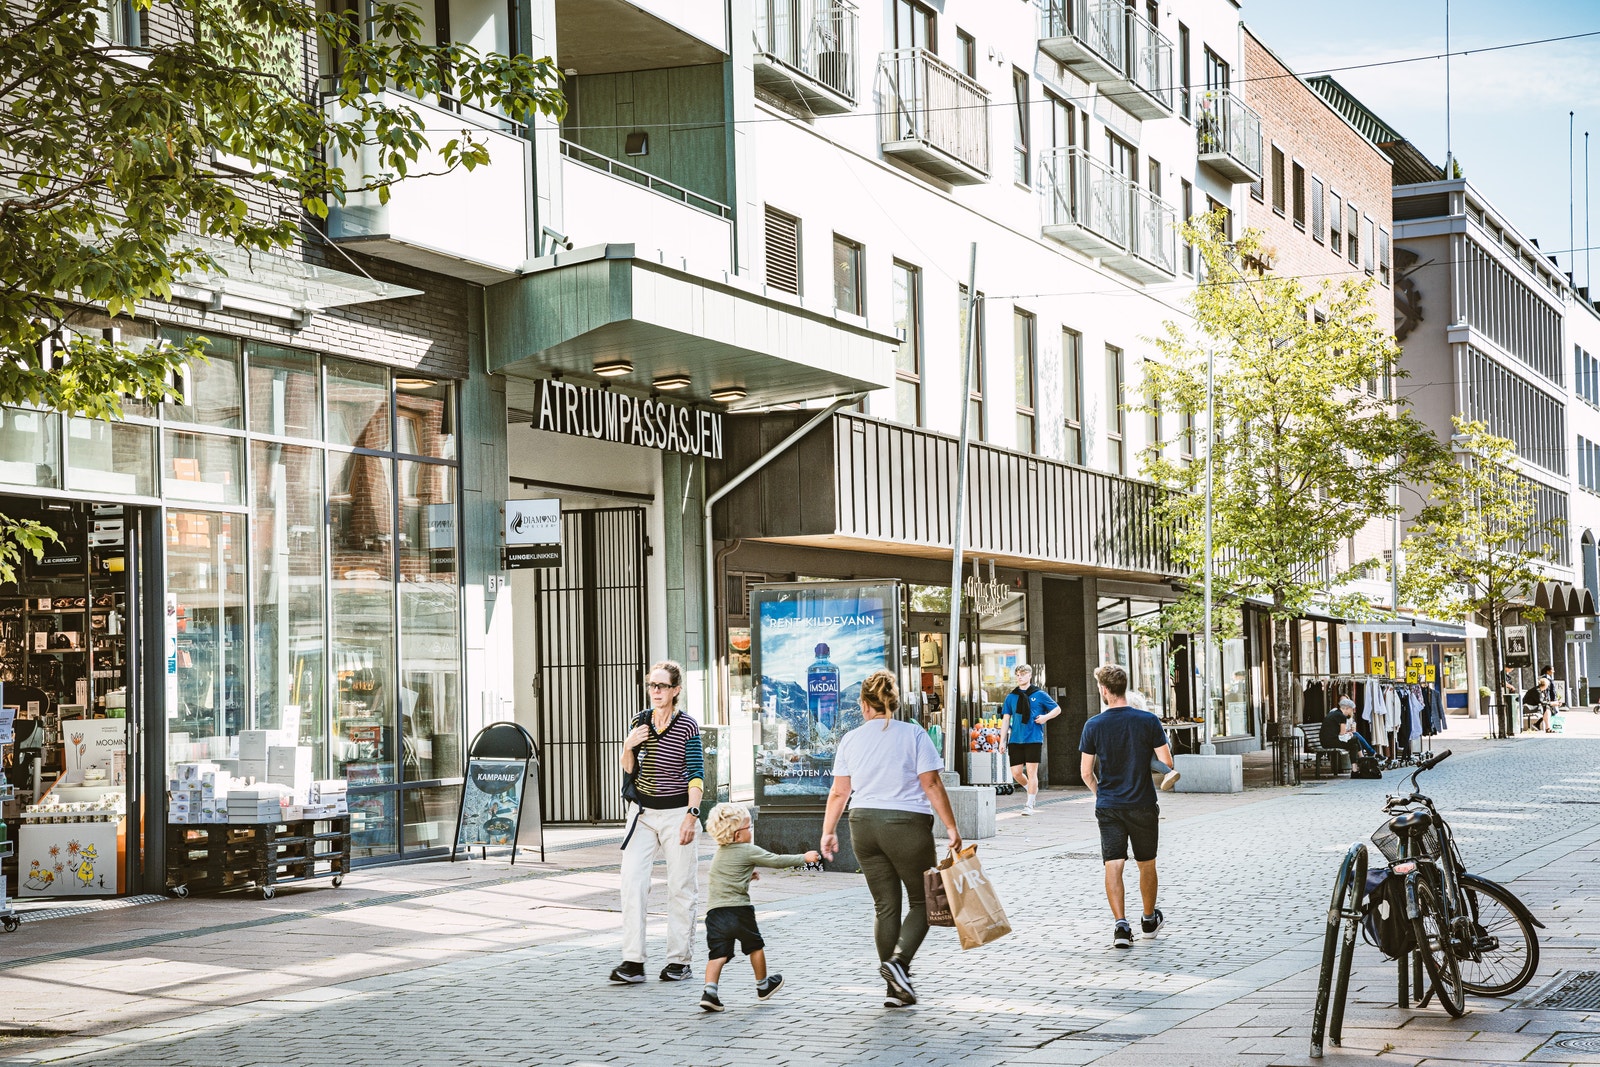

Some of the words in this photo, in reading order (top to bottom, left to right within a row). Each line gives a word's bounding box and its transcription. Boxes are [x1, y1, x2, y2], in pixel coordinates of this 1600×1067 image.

[539, 377, 723, 460] ATRIUMPASSASJEN
[508, 552, 559, 561] LUNGEKLINIKKEN
[769, 617, 801, 628] RENT
[803, 615, 875, 627] KILDEVANN
[809, 683, 838, 692] IMSDAL
[773, 769, 790, 777] FRA
[792, 769, 820, 777] FOTEN
